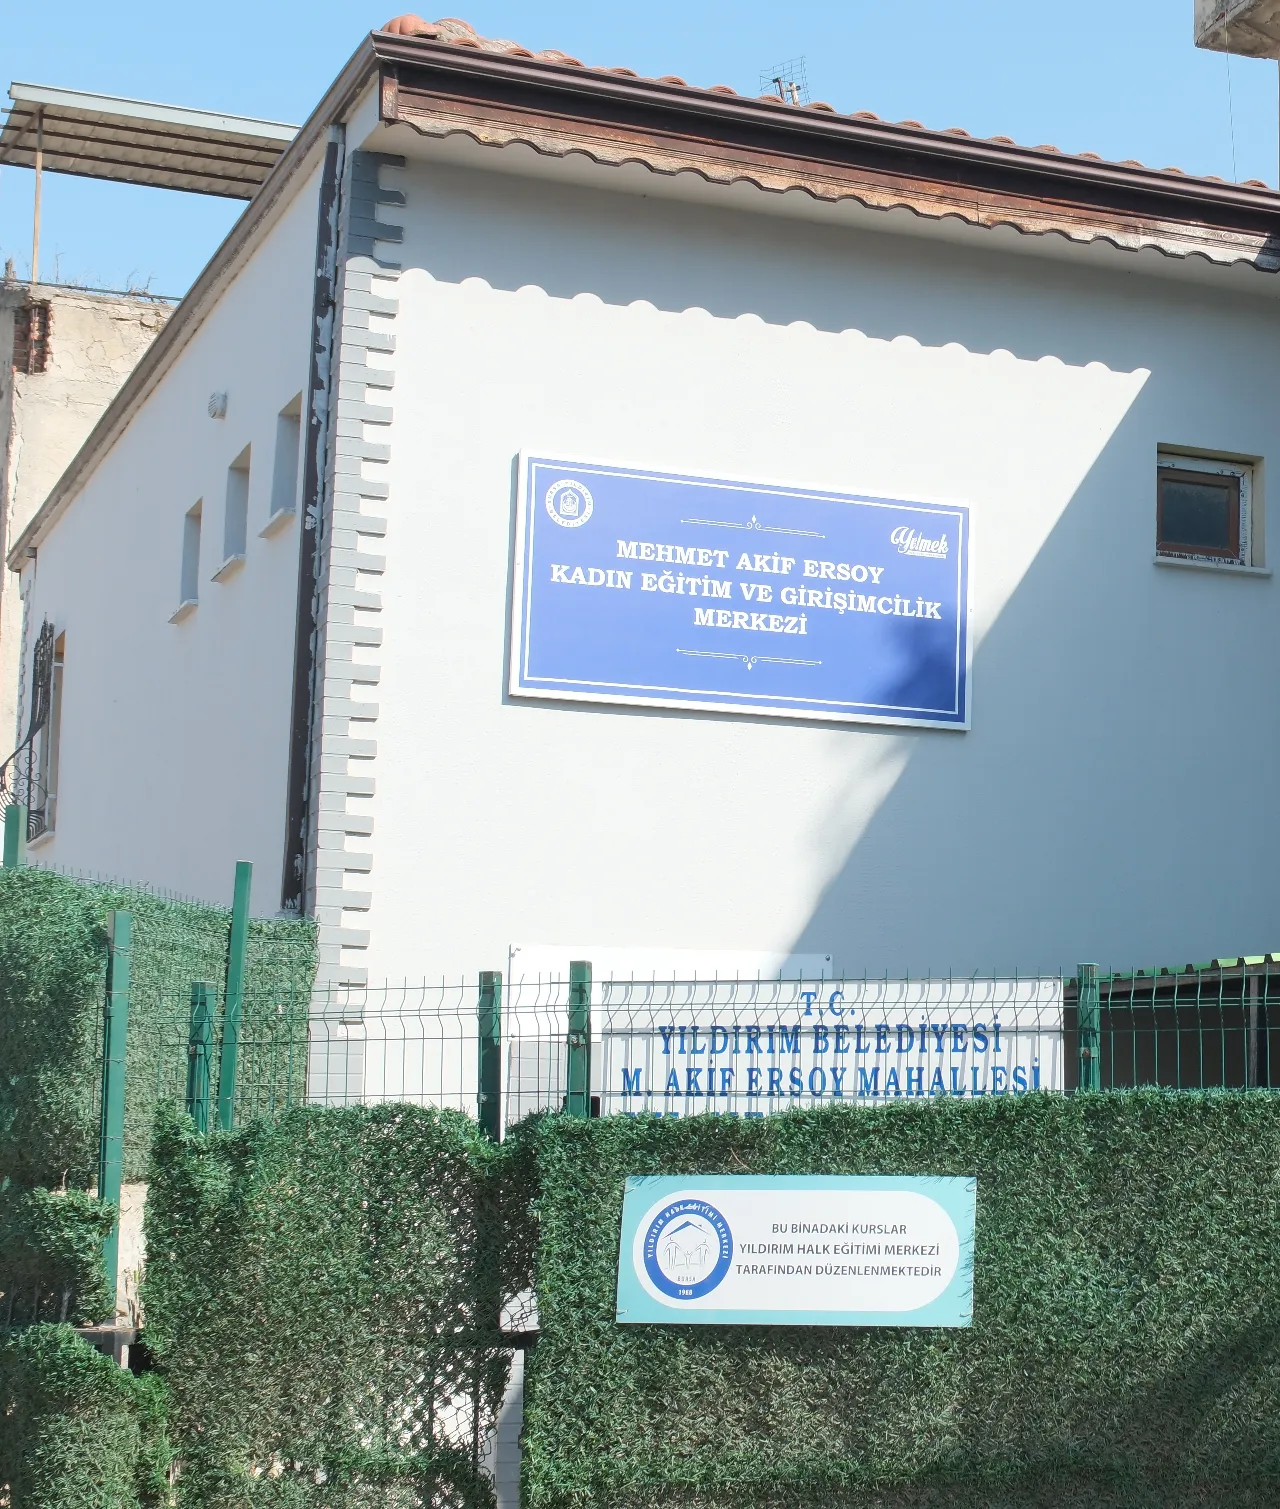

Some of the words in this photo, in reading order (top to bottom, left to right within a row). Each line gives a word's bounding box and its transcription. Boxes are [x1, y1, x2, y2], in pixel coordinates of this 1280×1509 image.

[616, 540, 729, 568] MEHMET
[736, 551, 796, 575] AKİF
[803, 559, 885, 584] ERSOY
[550, 564, 633, 589] KADIN
[640, 570, 732, 599] EĞİTİM
[740, 582, 773, 602] VE
[780, 584, 942, 619] GİRİŞİMCİLİK
[693, 607, 807, 635] MERKEZİ
[801, 990, 855, 1016] T.C.
[658, 1024, 800, 1054] YILDIRIM
[813, 1014, 1001, 1054] BELEDİYESİ
[621, 1067, 652, 1097] M.
[663, 1059, 735, 1097] AKİF
[746, 1066, 847, 1097] ERSOY
[858, 1057, 1041, 1097] MAHALLESİ
[772, 1223, 788, 1233] BU
[791, 1221, 849, 1234] BİNADAKİ
[852, 1224, 907, 1235] KURSLAR
[739, 1243, 794, 1254] YILDIRIM
[797, 1244, 830, 1255] HALK
[833, 1241, 881, 1255] EĞİTİMİ
[884, 1242, 940, 1256] MERKEZİ
[736, 1264, 812, 1275] TARAFINDAN
[815, 1263, 942, 1277] DÜZENLENMEKTEDİR
